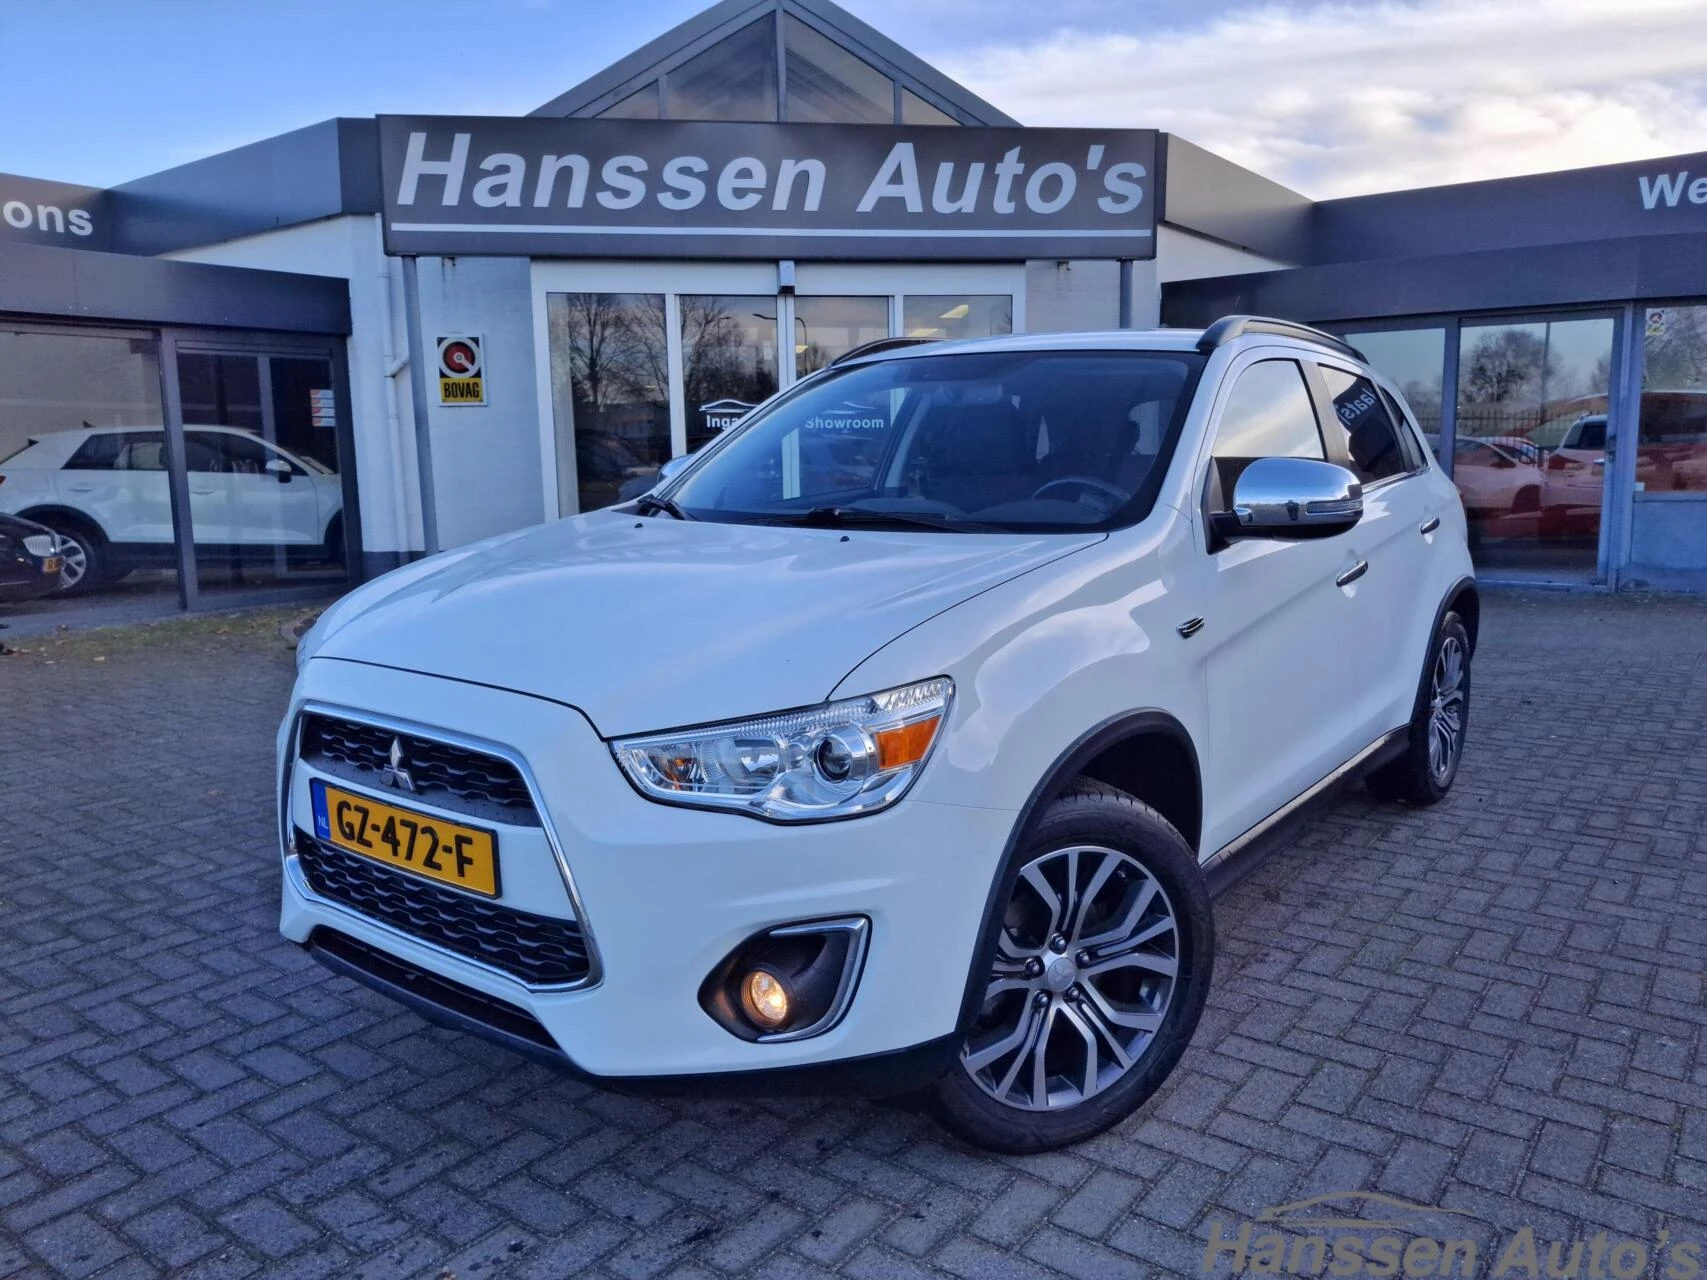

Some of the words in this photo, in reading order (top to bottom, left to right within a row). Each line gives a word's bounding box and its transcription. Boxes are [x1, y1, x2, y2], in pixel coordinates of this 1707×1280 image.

[397, 132, 827, 212] Hanssen
[855, 142, 1147, 214] Auto's
[1638, 171, 1707, 210] We
[3, 200, 94, 236] ons
[443, 382, 480, 398] BOVAG
[706, 414, 740, 431] Inga
[317, 815, 329, 830] NL
[336, 800, 474, 878] GZ-472-F
